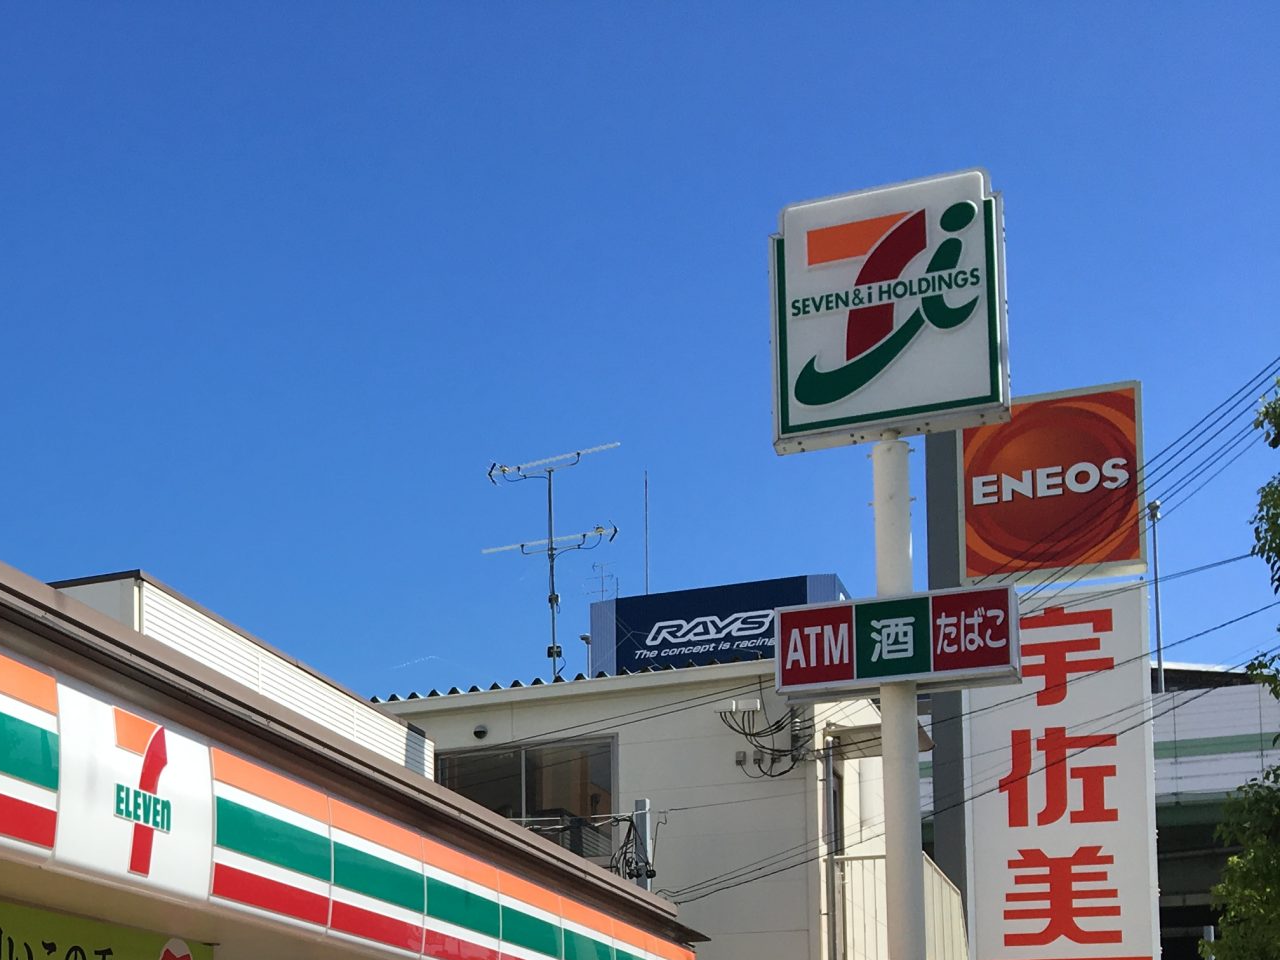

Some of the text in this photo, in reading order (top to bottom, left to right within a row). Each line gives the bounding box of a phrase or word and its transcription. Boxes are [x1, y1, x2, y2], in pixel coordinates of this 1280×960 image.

[879, 268, 980, 301] HOLDINGS
[972, 457, 1129, 505] ENEOS
[634, 649, 657, 660] The
[661, 642, 715, 657] concept
[719, 639, 731, 650] is
[646, 610, 775, 645] RAYS
[786, 623, 849, 669] ATM
[871, 616, 915, 662] 酒
[936, 607, 1006, 655] たばこ
[999, 606, 1122, 946] 宇佐美
